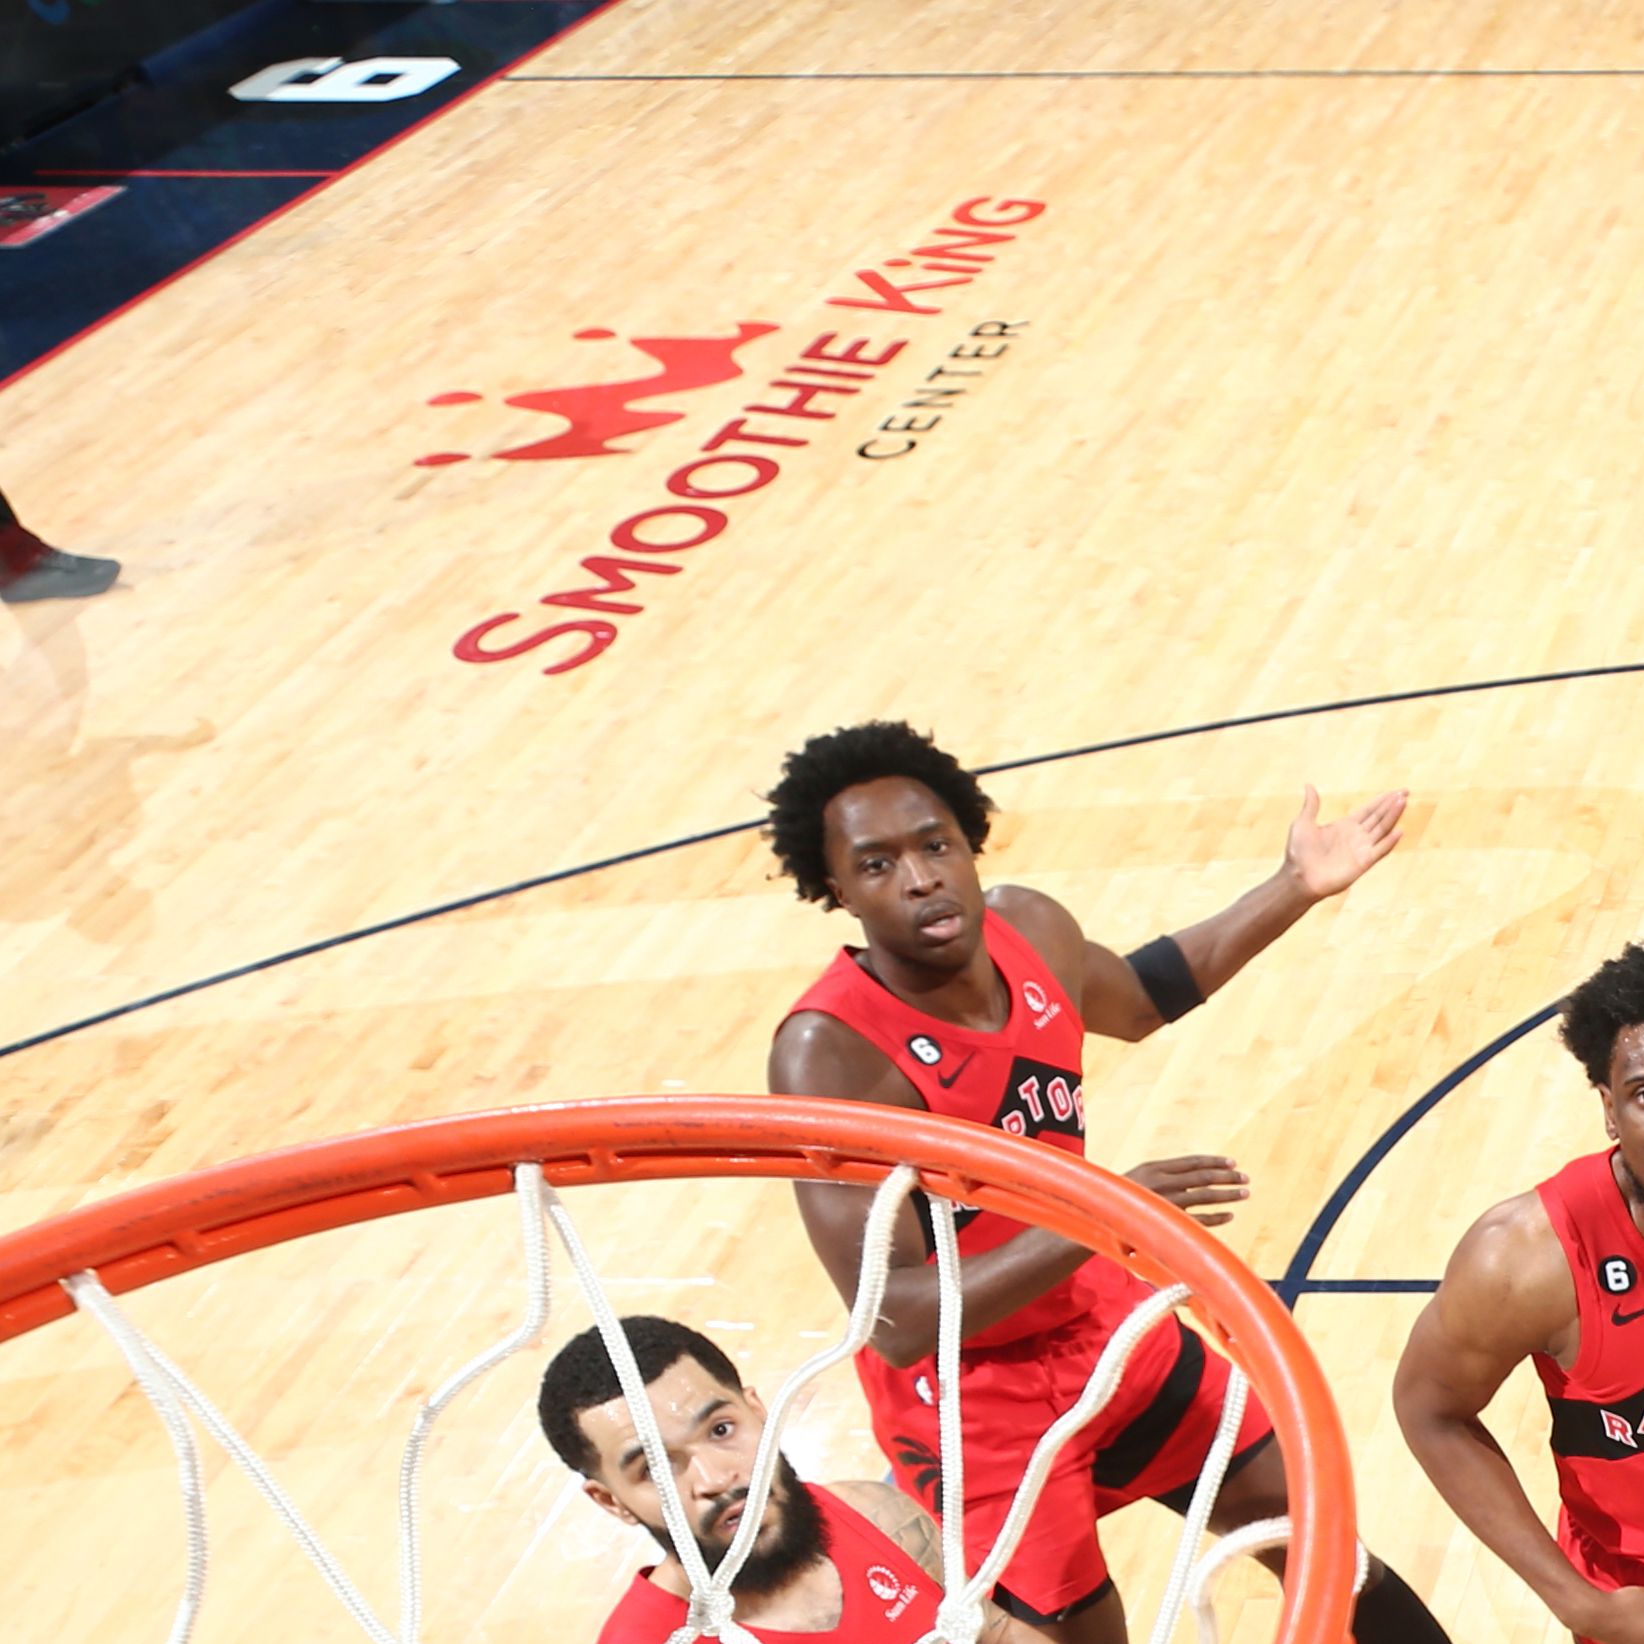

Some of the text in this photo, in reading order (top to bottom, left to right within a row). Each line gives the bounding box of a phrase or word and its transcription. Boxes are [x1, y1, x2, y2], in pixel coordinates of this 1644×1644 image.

[856, 318, 1031, 460] CENTER
[452, 331, 910, 676] SMOOTHIE
[910, 1037, 942, 1065] 6
[1605, 1260, 1631, 1292] 6
